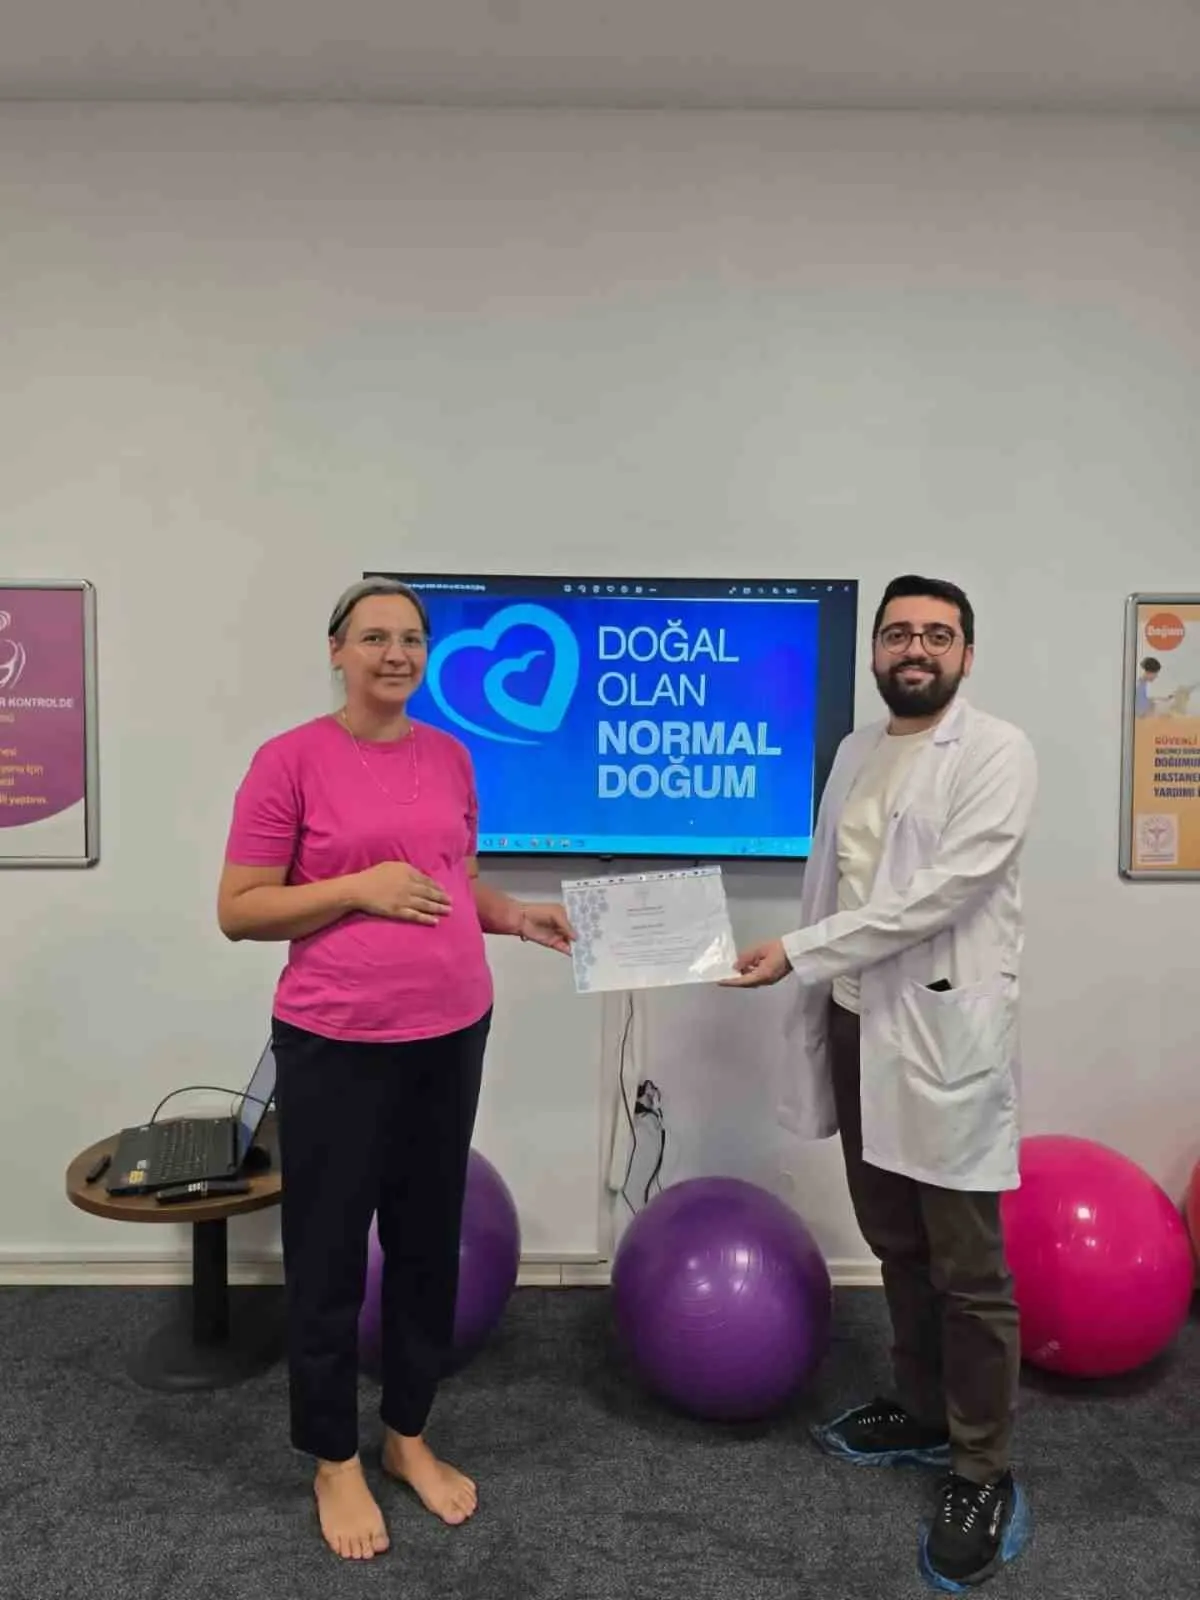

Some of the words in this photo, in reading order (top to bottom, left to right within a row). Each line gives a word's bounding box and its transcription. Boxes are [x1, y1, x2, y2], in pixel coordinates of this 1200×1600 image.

[598, 619, 740, 662] DOĞAL
[8, 697, 74, 709] KONTROLDE
[597, 671, 706, 707] OLAN
[598, 720, 782, 756] NORMAL
[598, 755, 756, 799] DOĞUM
